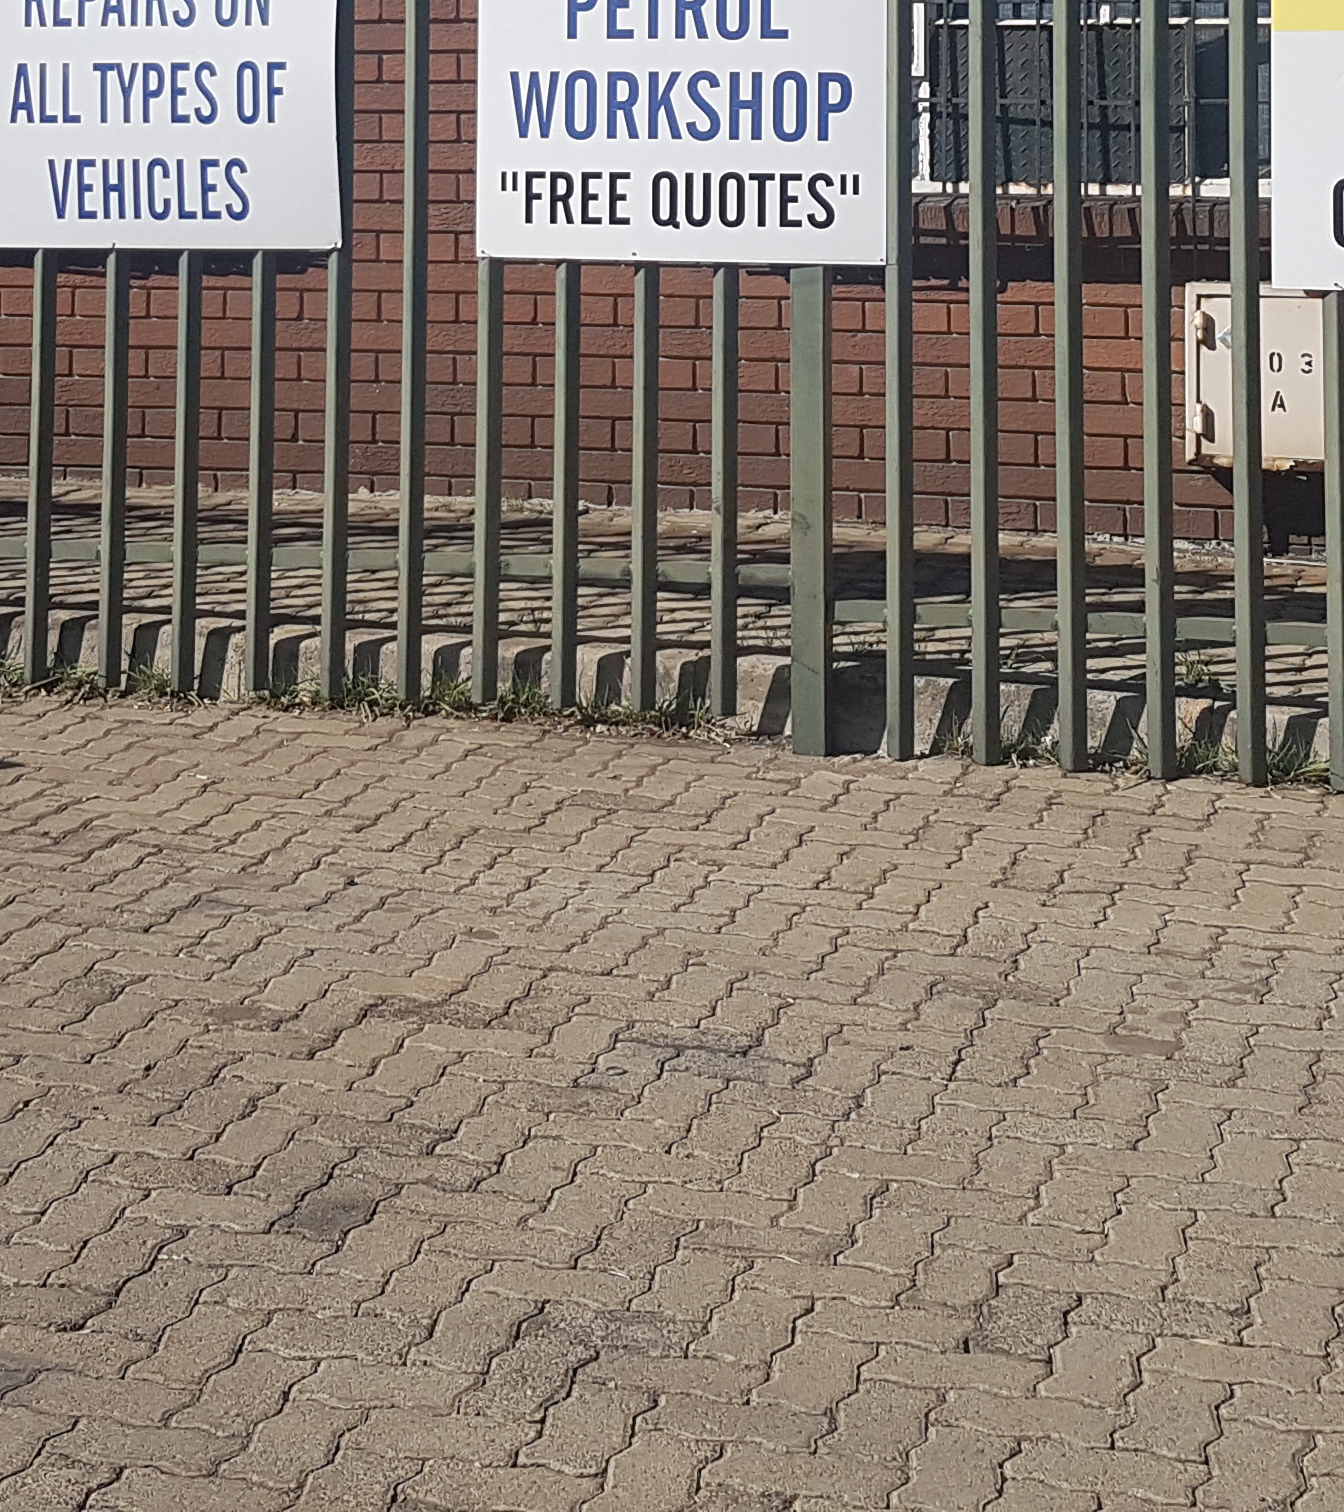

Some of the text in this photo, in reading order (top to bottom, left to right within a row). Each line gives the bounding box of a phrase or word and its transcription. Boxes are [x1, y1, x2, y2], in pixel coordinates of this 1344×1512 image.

[9, 60, 287, 124] ALL TYPES OF
[509, 70, 853, 143] WORKSHOP
[48, 158, 250, 221] VEHICLES
[500, 170, 860, 229] "FREE QUOTES"
[1271, 391, 1287, 413] A
